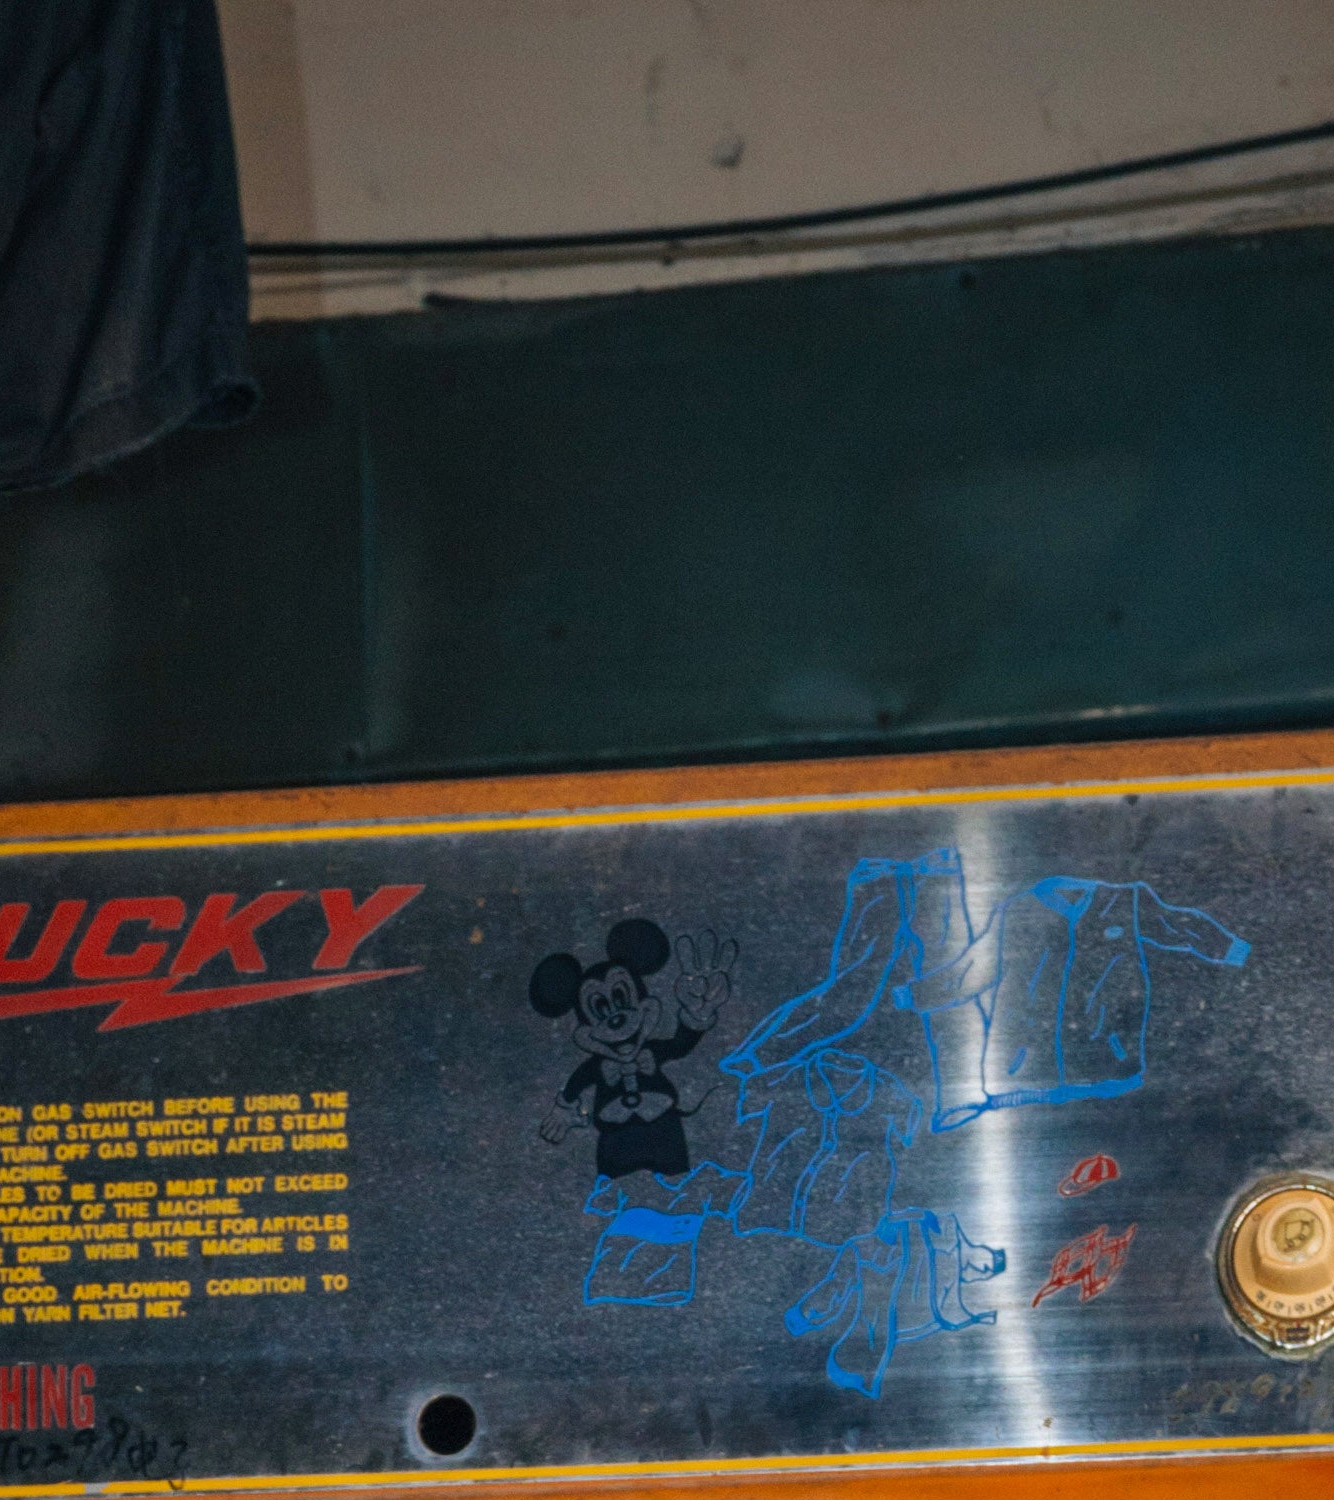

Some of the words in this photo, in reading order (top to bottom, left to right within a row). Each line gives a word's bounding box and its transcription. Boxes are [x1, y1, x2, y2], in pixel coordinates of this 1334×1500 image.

[32, 1103, 72, 1122] GAS
[83, 1101, 154, 1119] SWITCH
[164, 1096, 234, 1116] BEFORE
[245, 1094, 300, 1112] USING
[311, 1091, 347, 1109] THE
[27, 1124, 59, 1143] (OR
[66, 1122, 129, 1140] STEAM
[136, 1119, 207, 1137] SWITCH
[212, 1117, 229, 1134] IF
[234, 1116, 251, 1132] IT
[257, 1115, 275, 1132] IS
[282, 1112, 345, 1131] STEAM
[1, 1145, 47, 1163] TURN
[55, 1143, 90, 1161] OFF
[98, 1141, 137, 1159] GAS
[146, 1138, 218, 1157] SWITCH
[226, 1135, 283, 1153] AFTER
[291, 1132, 348, 1151] USING
[36, 1185, 61, 1202] TO
[71, 1183, 95, 1201] BE
[104, 1181, 158, 1199] DRIED
[166, 1178, 217, 1196] MUST
[226, 1176, 265, 1193] NOT
[275, 1173, 348, 1192] EXCEED
[80, 1203, 104, 1221] OF
[114, 1201, 148, 1218] THE
[157, 1198, 241, 1216] MACHINE.
[1, 1222, 128, 1243] TEMPERATURE
[132, 1219, 217, 1238] SUITABLE
[220, 1217, 258, 1234] FOR
[262, 1214, 348, 1232] ARTICLES
[17, 1245, 71, 1262] DRIED
[84, 1243, 139, 1260] WHEN
[153, 1240, 187, 1257] THE
[202, 1236, 283, 1255] MACHINE
[297, 1235, 315, 1251] IS
[329, 1234, 348, 1250] IN
[2, 1285, 57, 1304] GOOD
[73, 1280, 190, 1301] AIR-FLOWING
[206, 1277, 305, 1296] CONDITION
[322, 1274, 348, 1290] TO
[23, 1305, 71, 1322] YARN
[78, 1302, 138, 1320] FILTER
[145, 1300, 185, 1318] NET.
